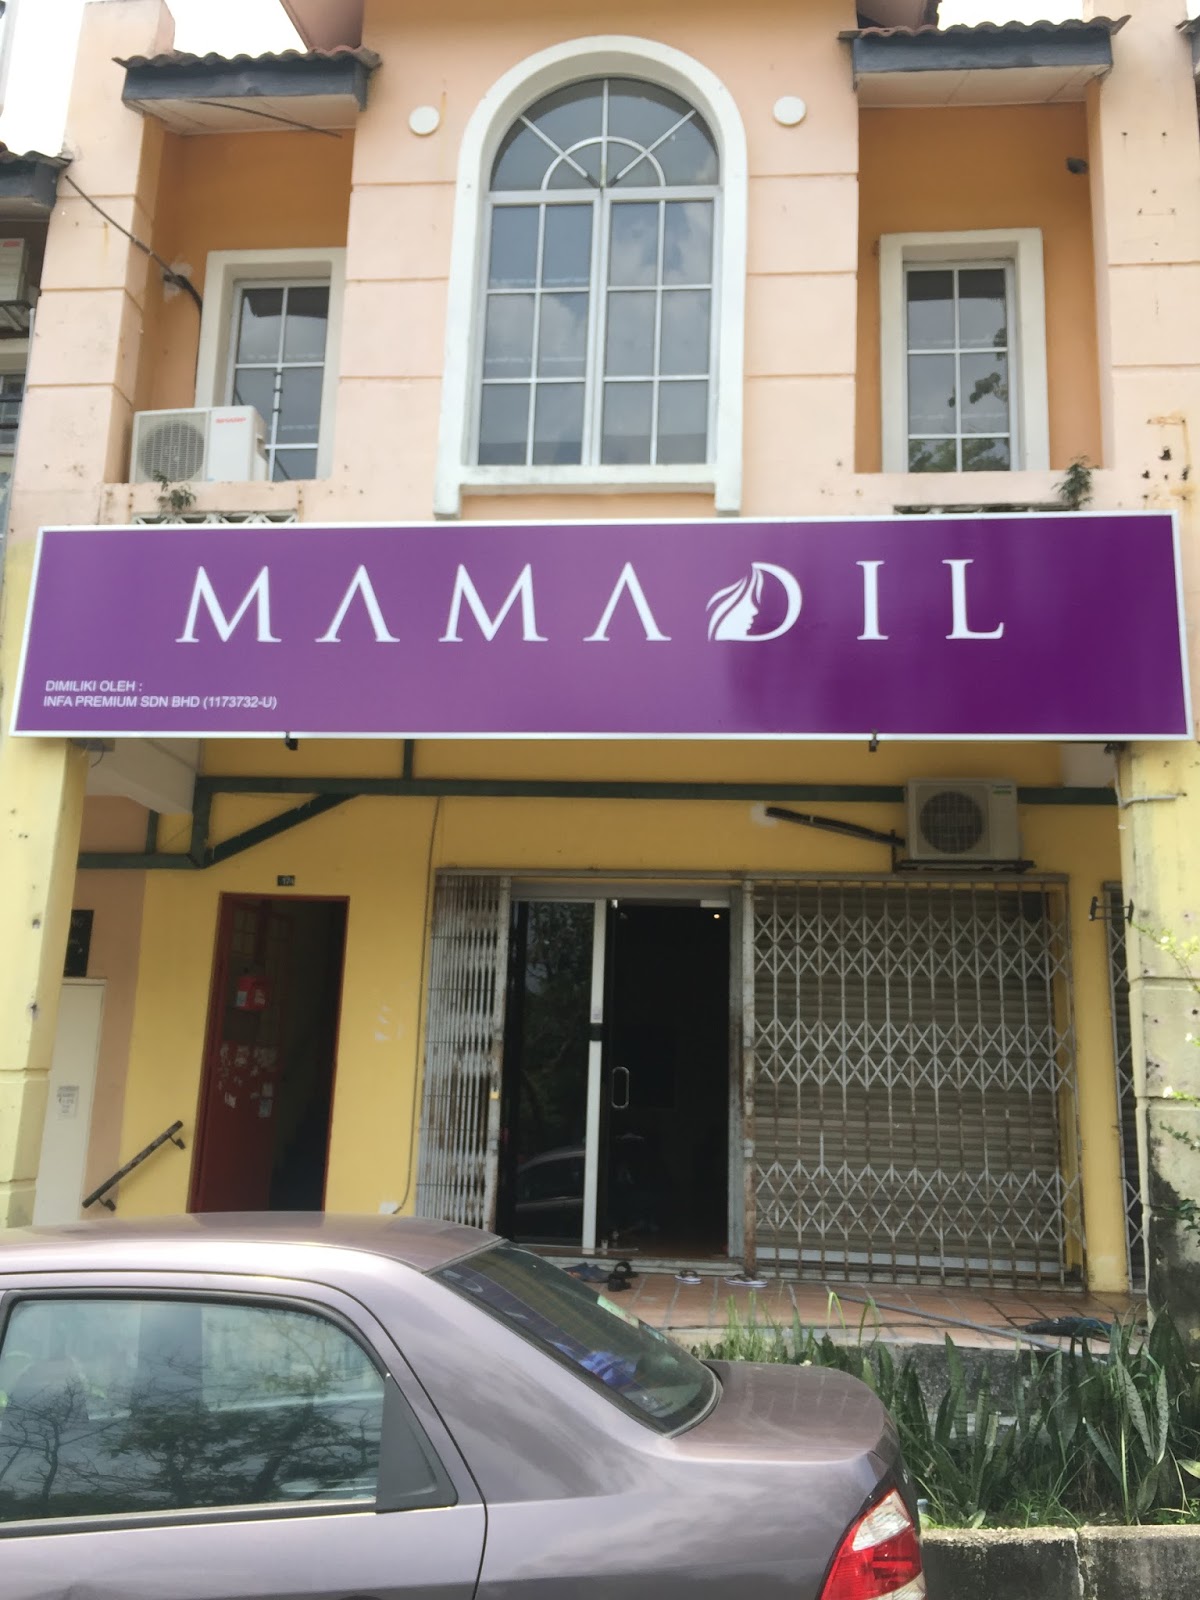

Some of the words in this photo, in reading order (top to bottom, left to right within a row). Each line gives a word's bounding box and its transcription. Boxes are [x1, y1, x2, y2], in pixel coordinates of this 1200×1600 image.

[175, 559, 1005, 643] MAMADIL
[45, 680, 97, 692] DIMILIKI
[99, 680, 136, 692] OLEH
[43, 695, 73, 707] INFA
[75, 695, 138, 707] PREMIUM
[140, 695, 169, 707] SDN
[171, 695, 200, 707] BHD
[203, 695, 278, 710] (1173732-U)
